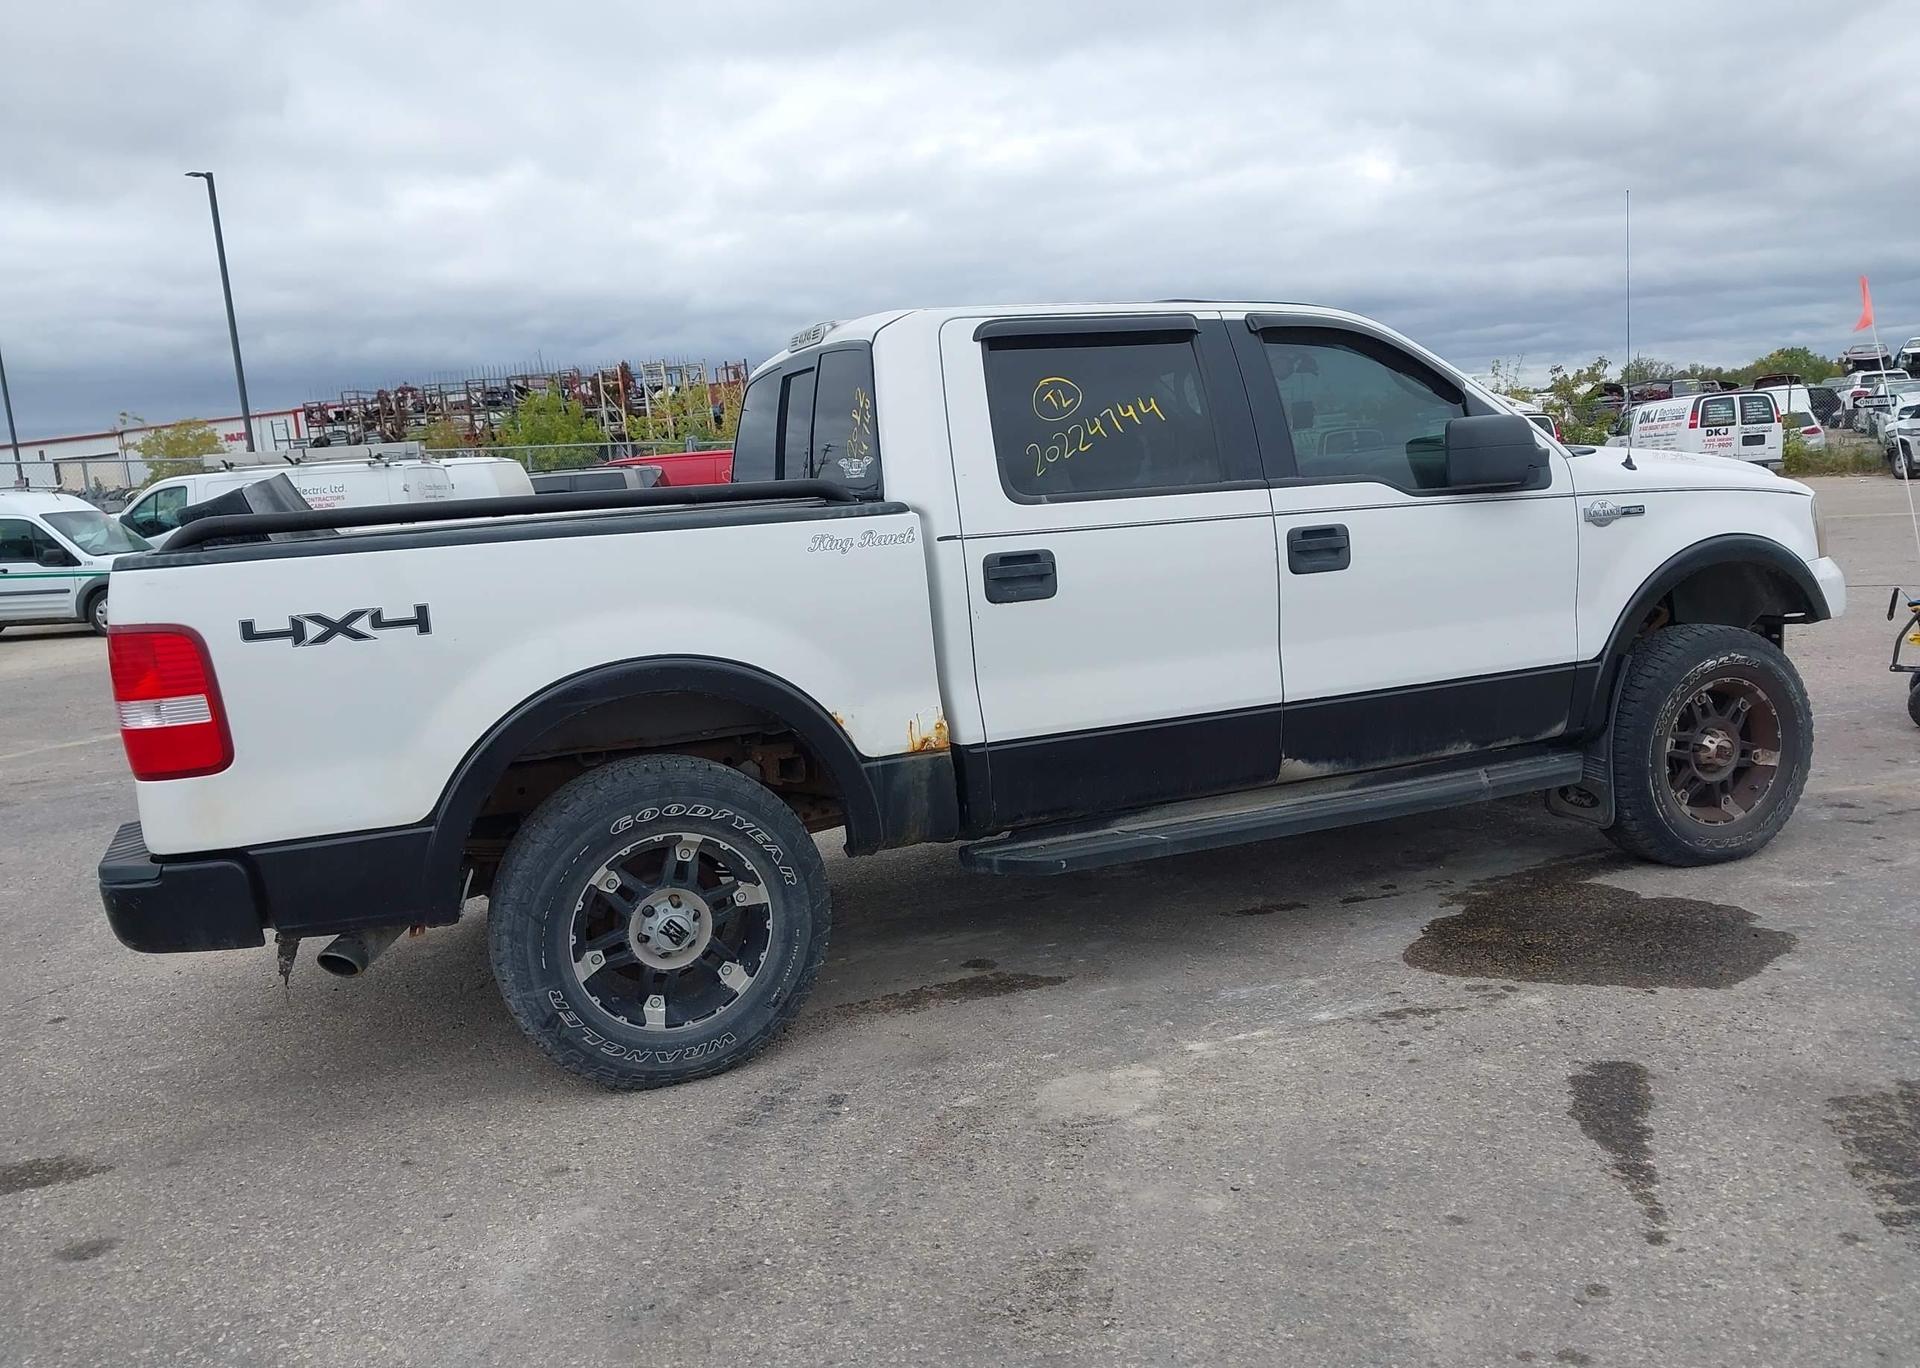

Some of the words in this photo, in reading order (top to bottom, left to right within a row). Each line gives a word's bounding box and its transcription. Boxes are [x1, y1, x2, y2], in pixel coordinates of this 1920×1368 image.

[1639, 408, 1658, 424] DKJ
[1026, 397, 1166, 477] 20224744
[1705, 428, 1729, 437] DKJ
[330, 483, 347, 494] Ltd.
[807, 533, 854, 554] King
[857, 527, 916, 548] Ranch
[609, 803, 798, 886] GOODYEAR
[548, 990, 737, 1064] WRANGLER
